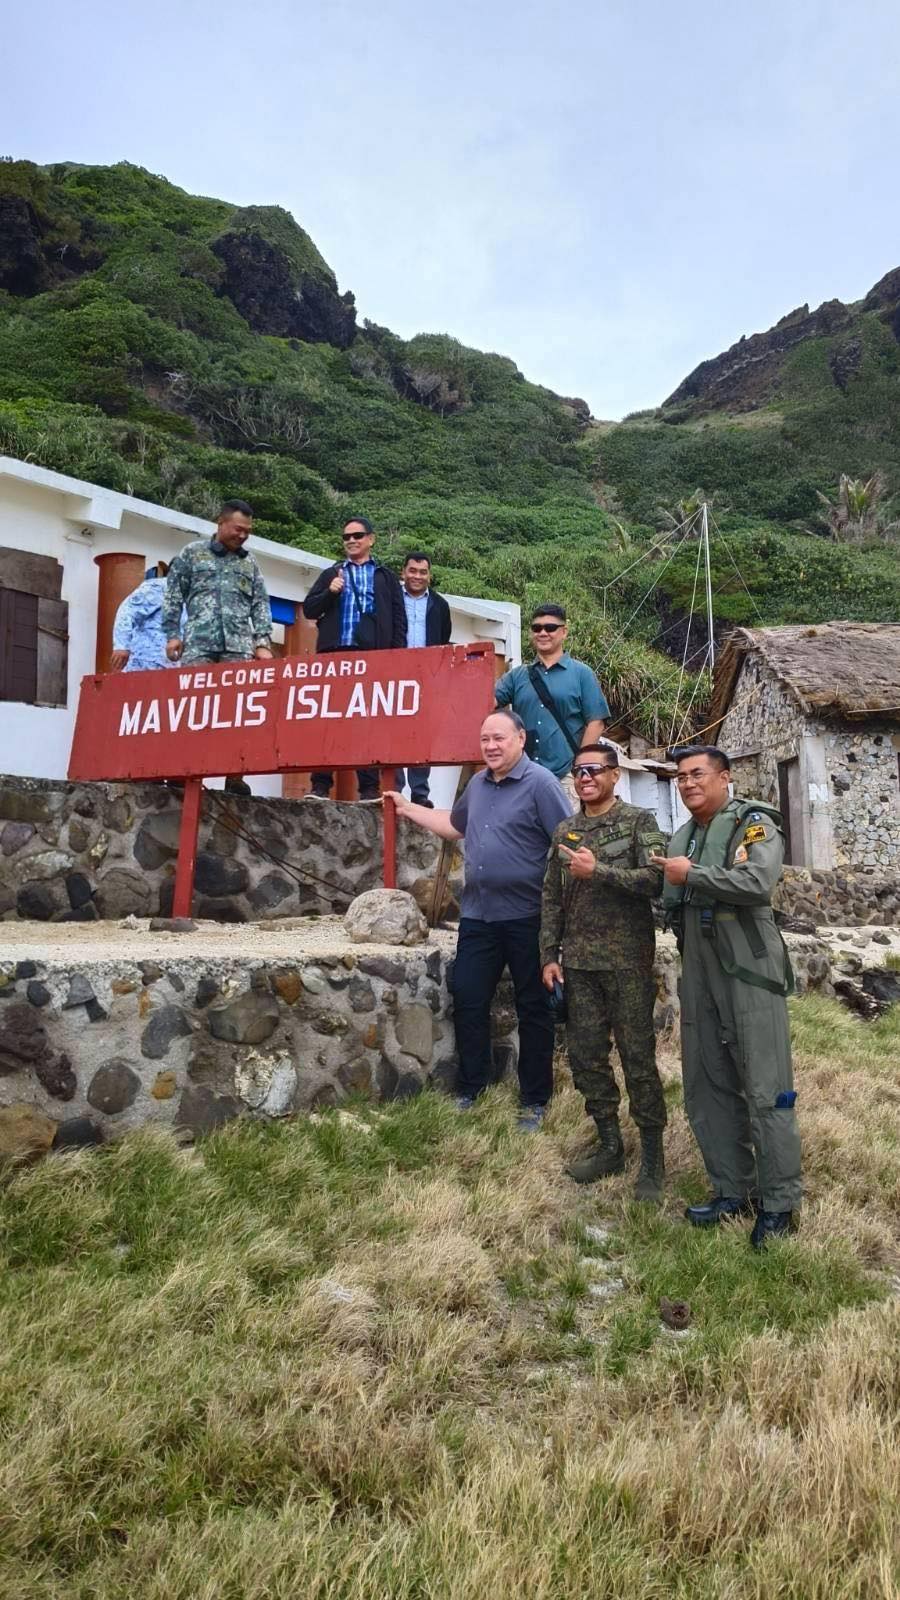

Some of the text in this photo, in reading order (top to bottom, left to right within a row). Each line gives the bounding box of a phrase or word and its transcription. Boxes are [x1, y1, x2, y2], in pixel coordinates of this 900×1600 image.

[178, 659, 368, 690] WELCOME ABOARD
[118, 679, 421, 737] MAVULIS ISLAND
